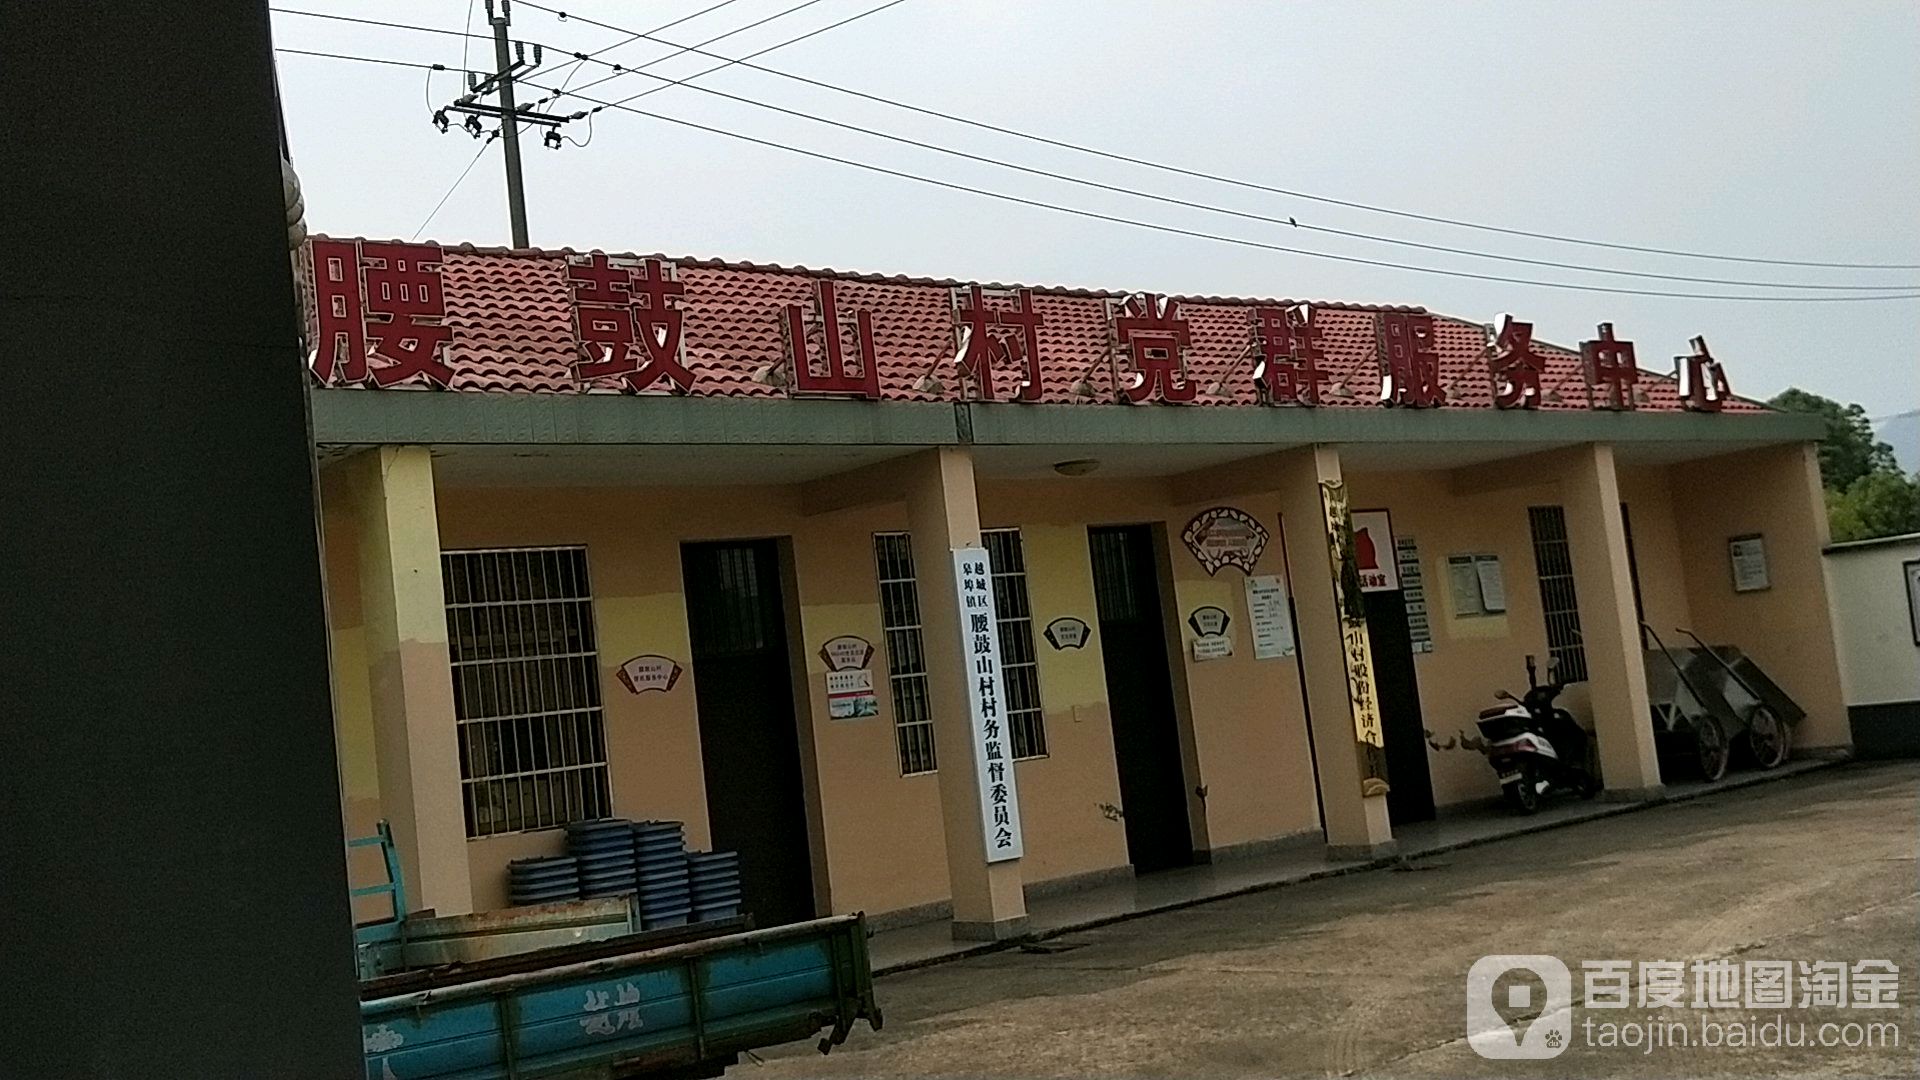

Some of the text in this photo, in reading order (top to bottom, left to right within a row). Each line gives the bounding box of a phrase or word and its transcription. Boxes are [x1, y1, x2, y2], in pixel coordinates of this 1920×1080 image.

[310, 238, 1729, 411] 腰鼓山村党群服务中心
[974, 561, 989, 608] 越城区
[970, 612, 1013, 849] 腰鼓山村村务监督委员会
